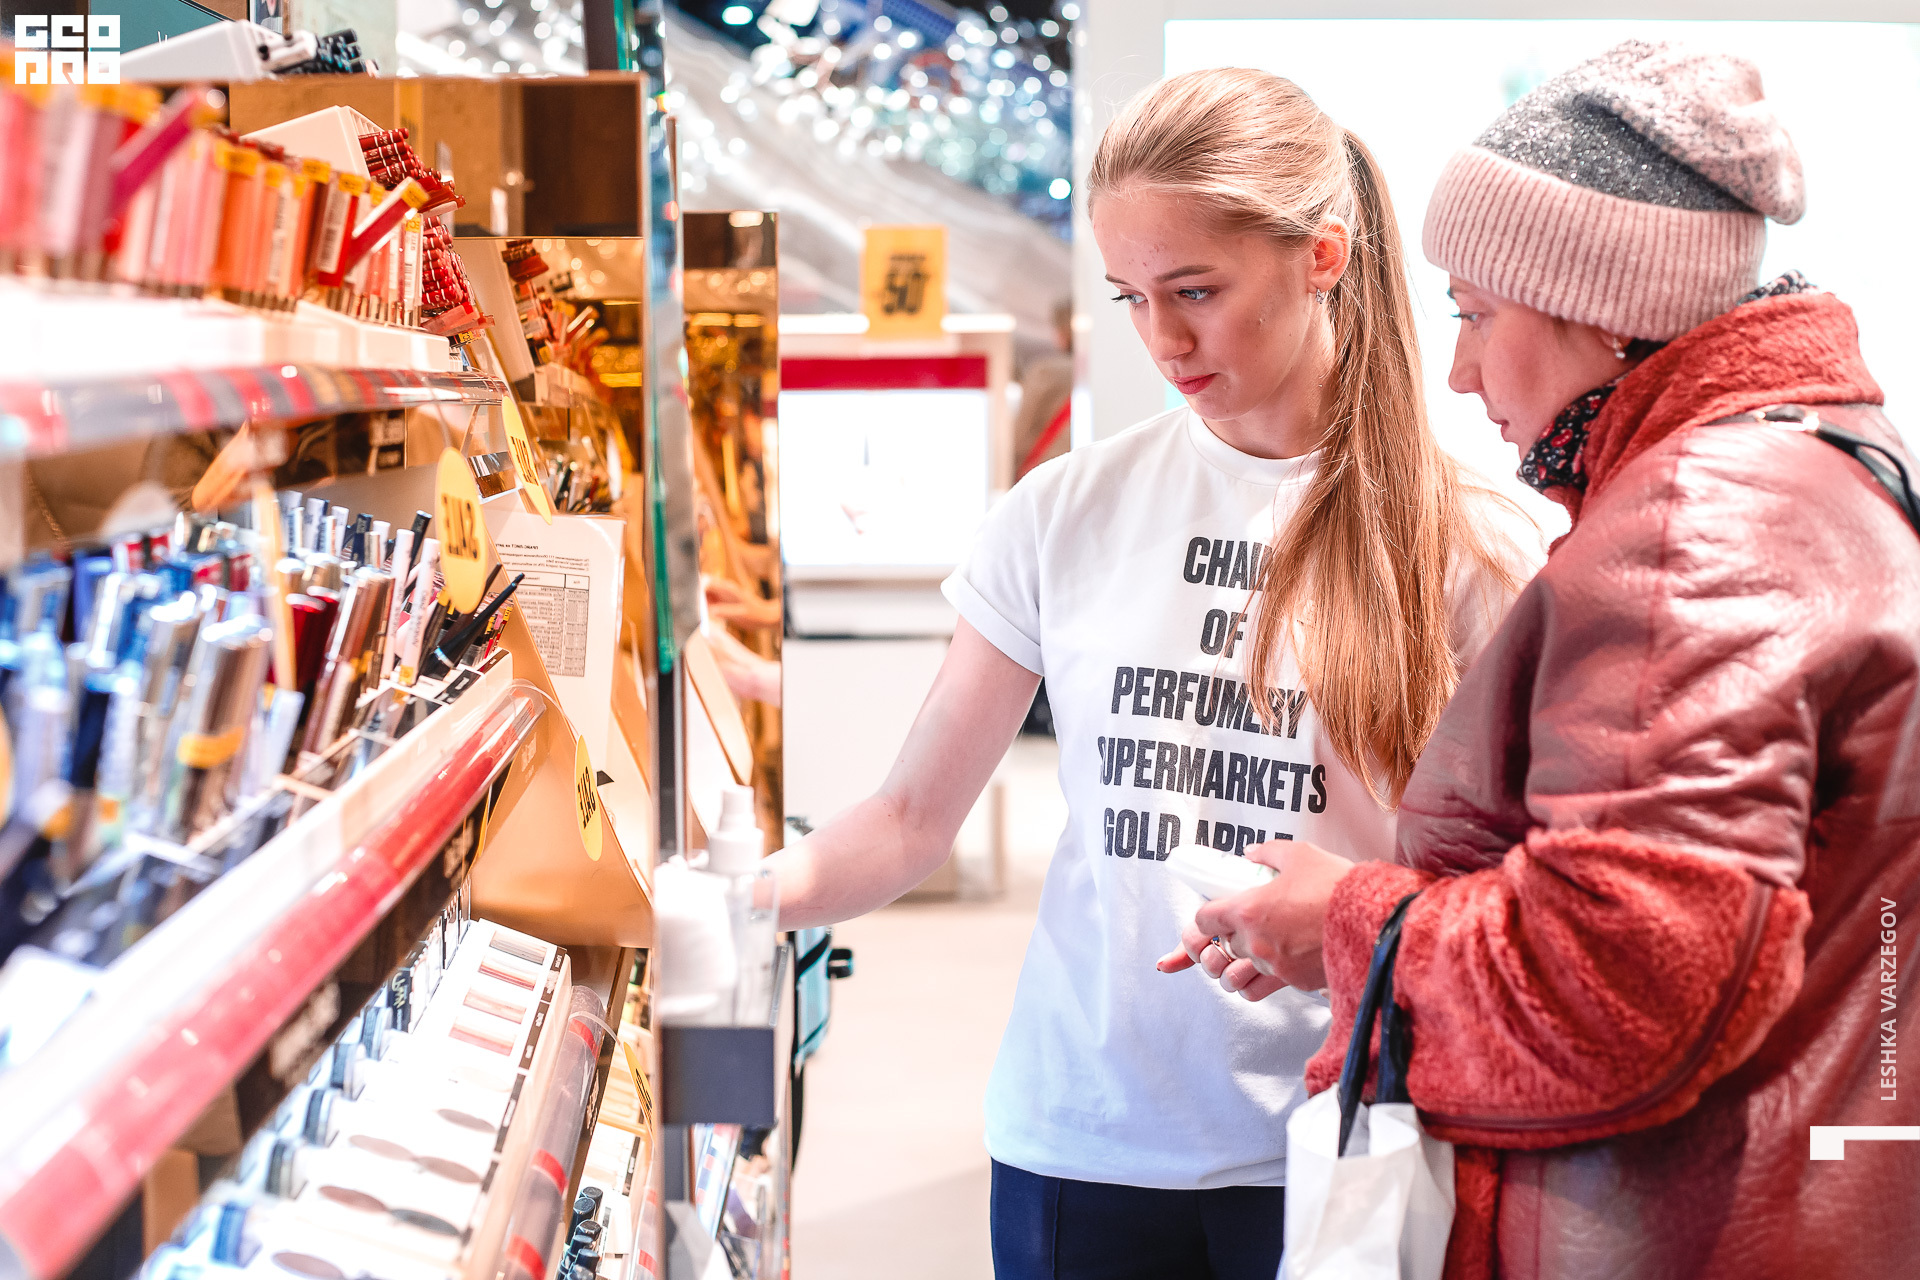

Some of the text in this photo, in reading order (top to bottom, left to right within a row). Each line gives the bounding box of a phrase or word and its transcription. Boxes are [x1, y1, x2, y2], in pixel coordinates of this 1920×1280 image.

[1200, 608, 1248, 659] OF
[1103, 807, 1293, 861] GOLD APP
